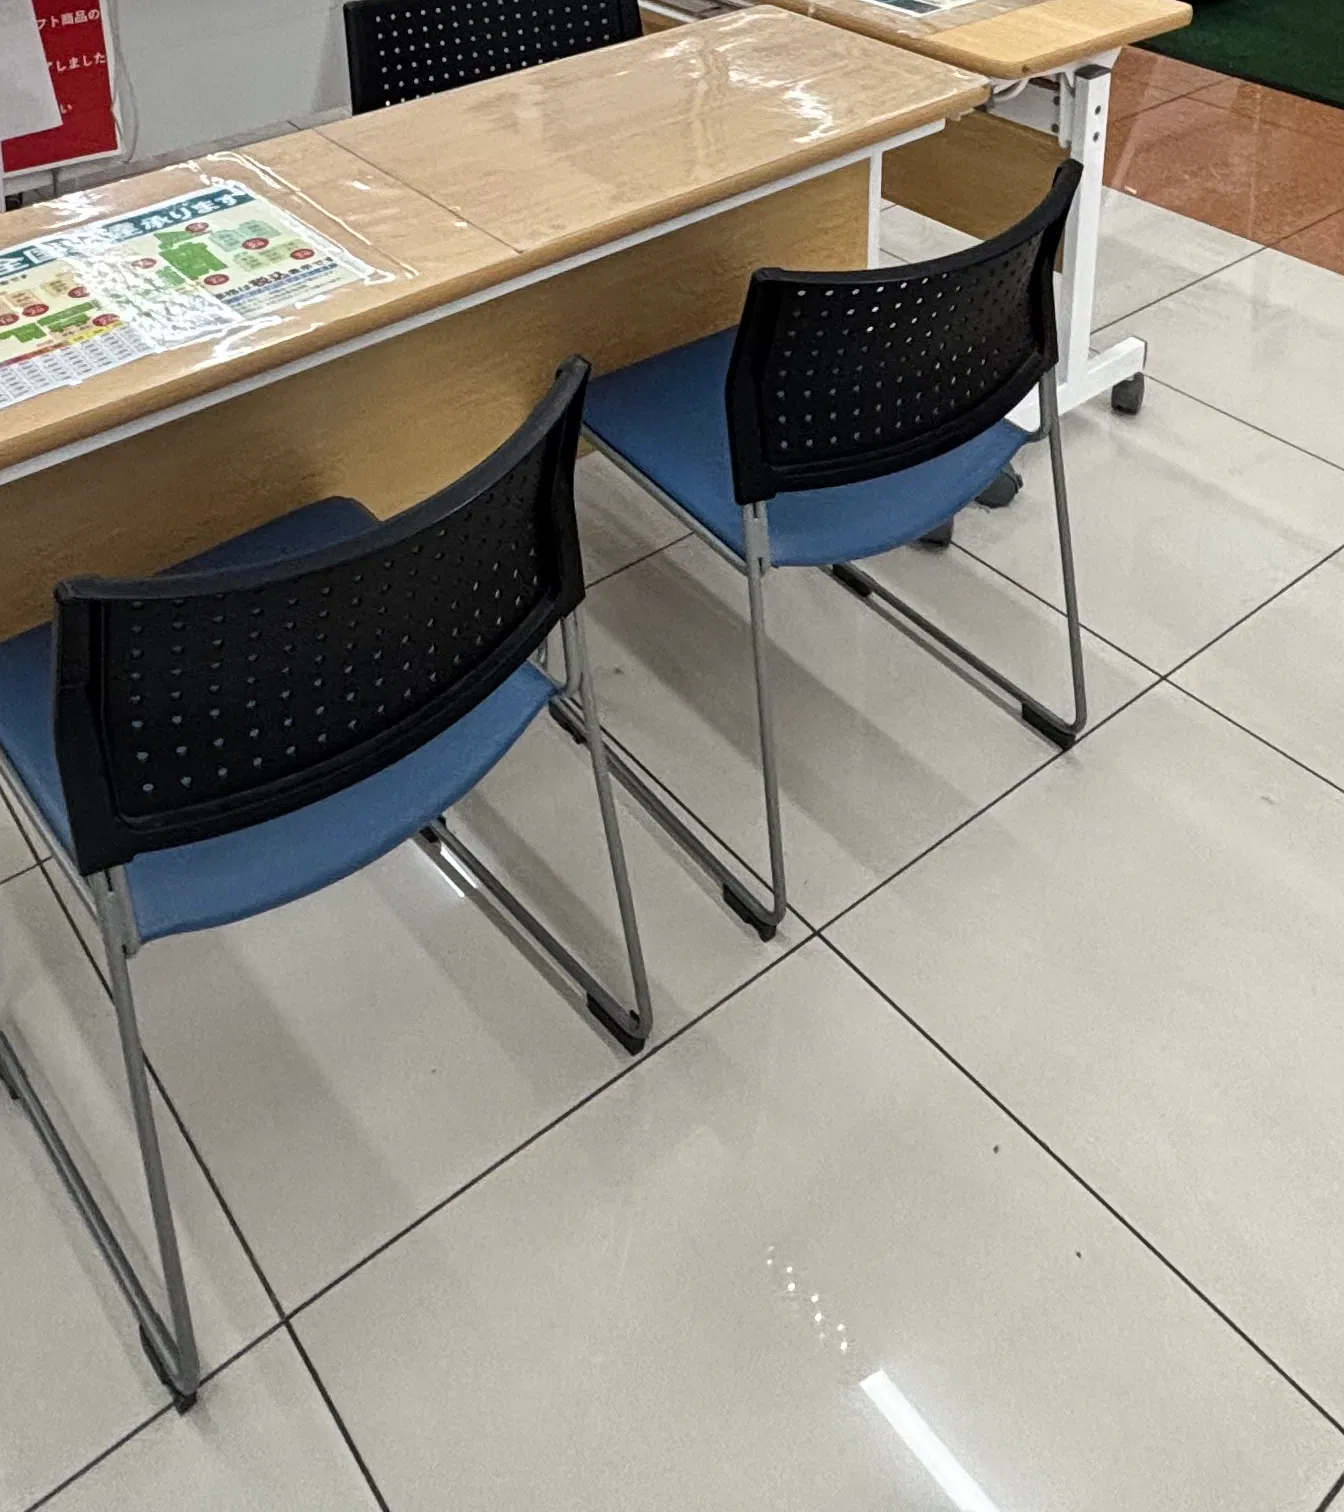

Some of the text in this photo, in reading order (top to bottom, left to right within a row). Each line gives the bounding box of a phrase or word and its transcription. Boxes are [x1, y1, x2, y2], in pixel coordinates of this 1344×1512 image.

[36, 8, 101, 31] フト商品の
